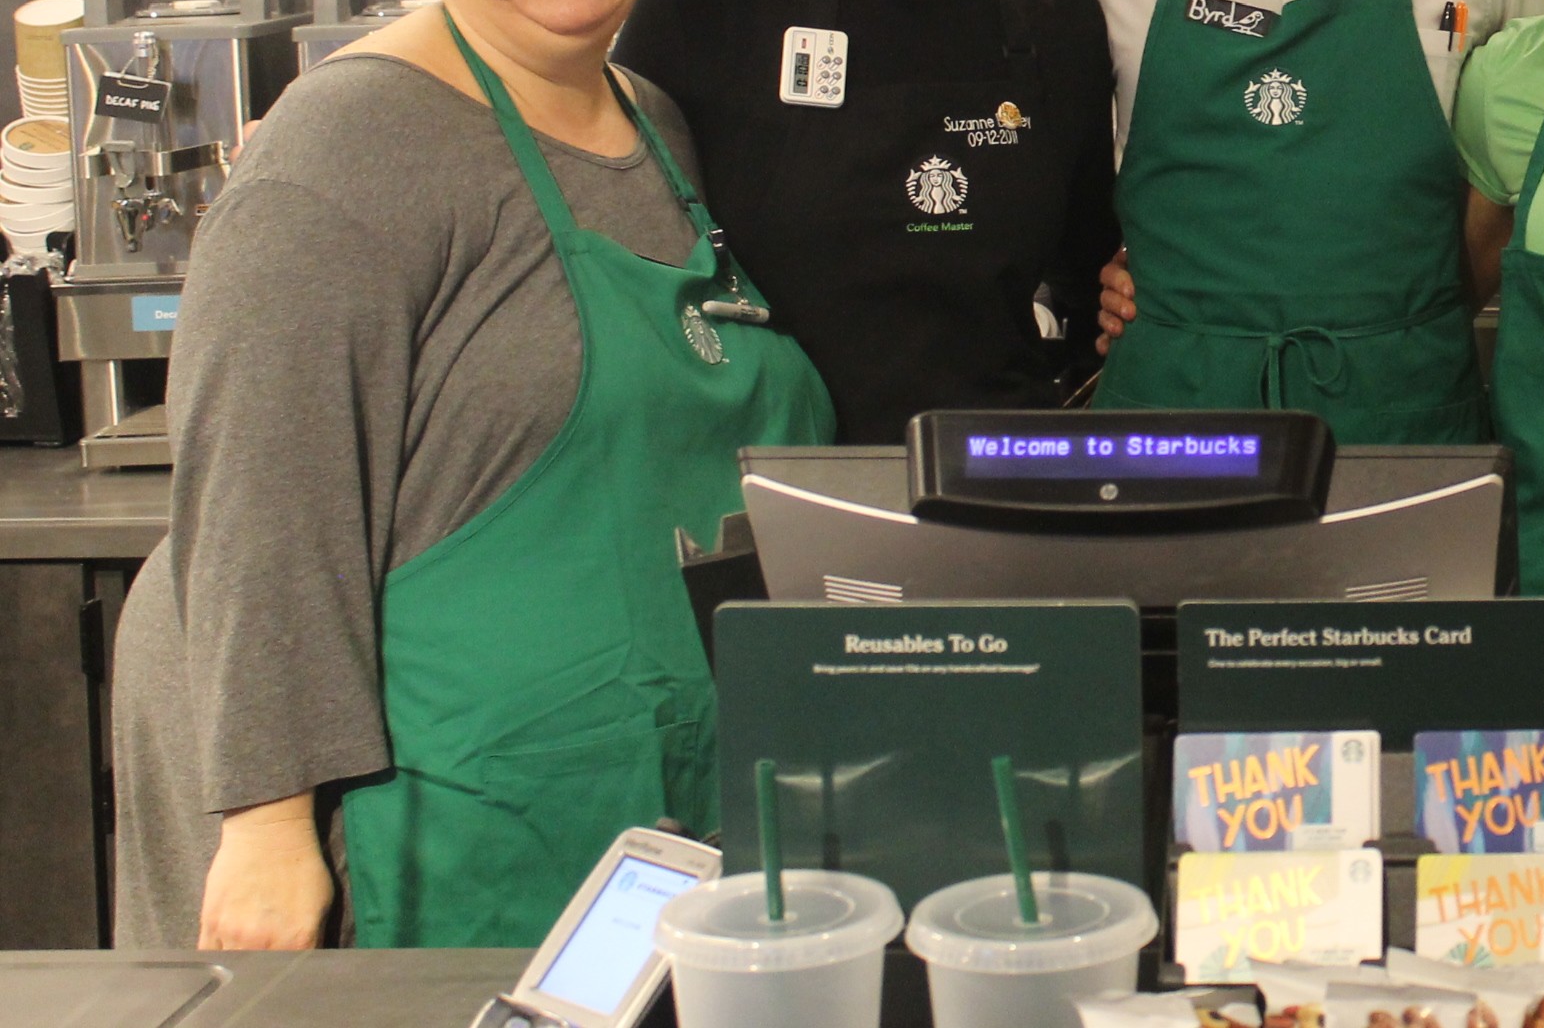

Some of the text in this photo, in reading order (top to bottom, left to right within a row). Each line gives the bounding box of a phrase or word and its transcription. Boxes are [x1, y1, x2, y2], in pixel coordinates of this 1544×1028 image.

[106, 95, 138, 108] DECAF
[944, 116, 995, 132] Suzanne
[968, 129, 1018, 147] 09-12-2011
[906, 220, 974, 233] Coffee Master
[969, 436, 1257, 458] Welcome to Starbucks
[845, 633, 1008, 654] Reusables To Go
[1204, 626, 1472, 647] The Perfect Starbucks Card
[1187, 743, 1322, 808] THANK
[1216, 795, 1303, 849] YOU
[1456, 790, 1542, 842] YOU
[1458, 915, 1543, 968] YOU
